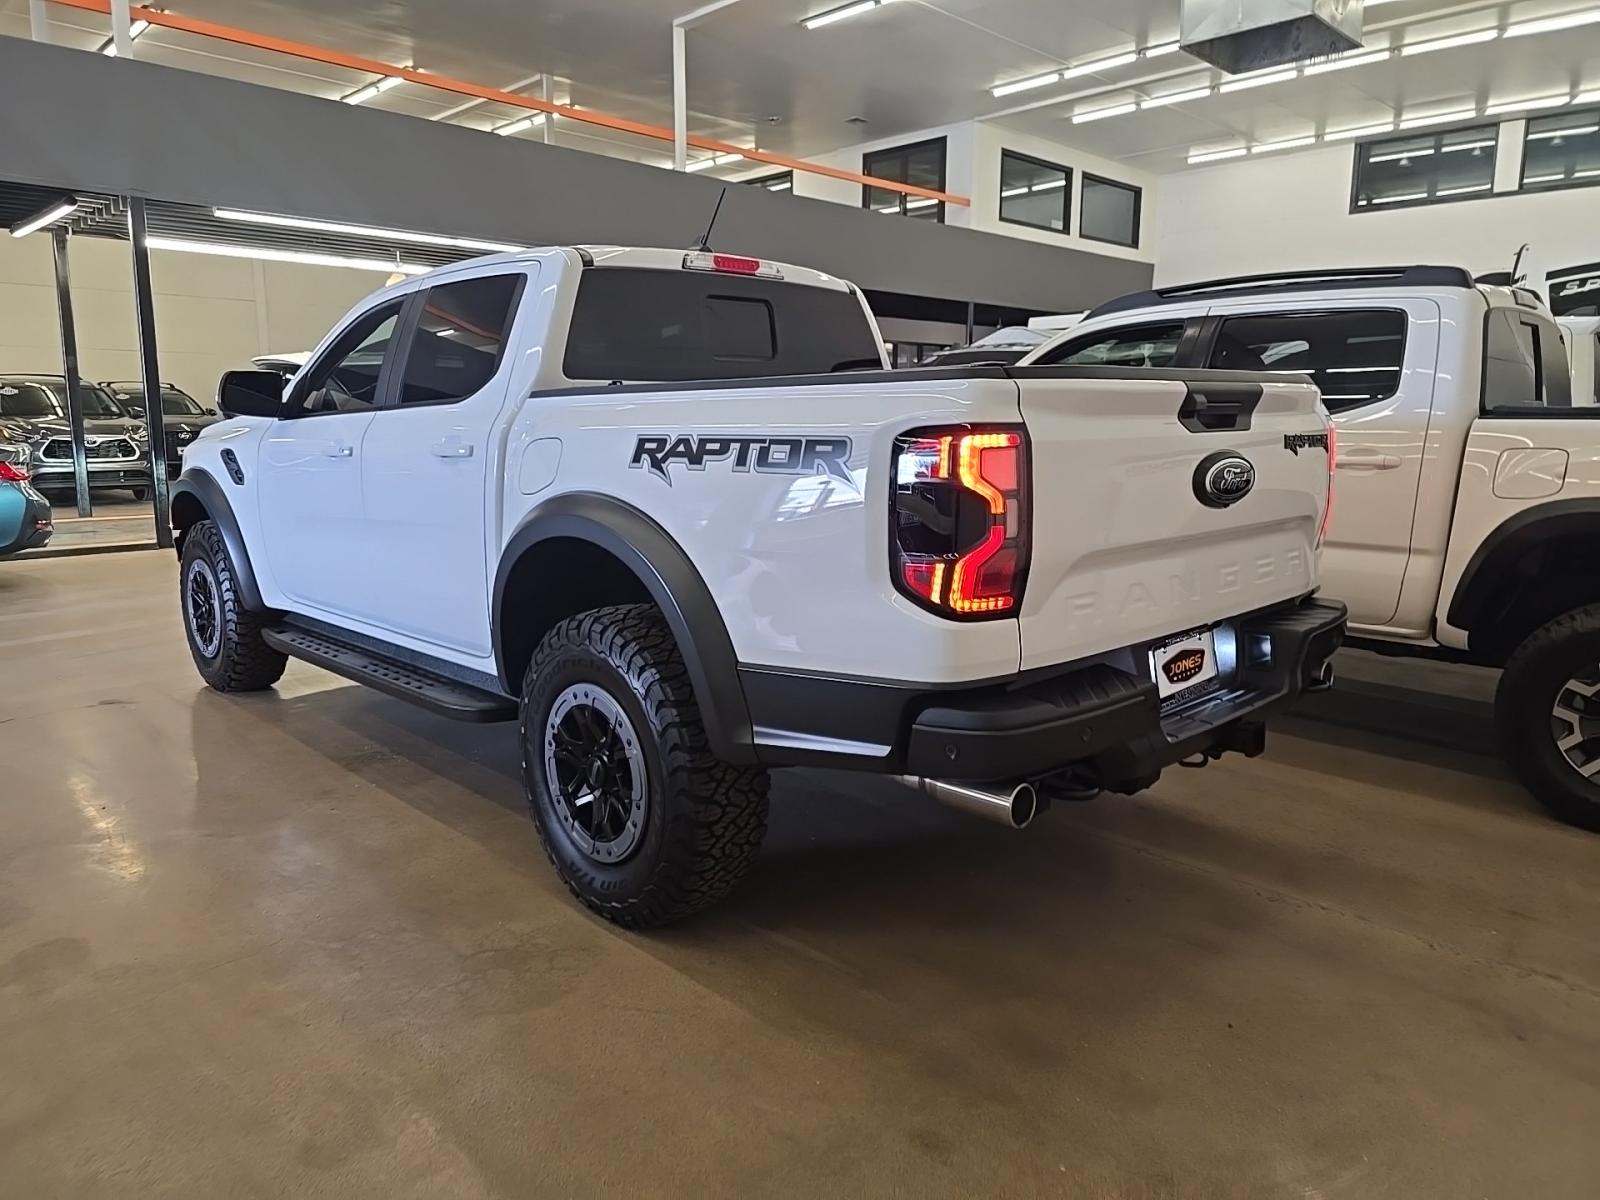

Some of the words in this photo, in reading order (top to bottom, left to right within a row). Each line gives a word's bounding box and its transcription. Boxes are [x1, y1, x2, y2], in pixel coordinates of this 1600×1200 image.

[1283, 433, 1329, 457] RAPTOR
[628, 434, 858, 486] RAPTOR
[1219, 466, 1249, 491] Ford
[1064, 549, 1303, 628] RANGER
[1169, 654, 1202, 677] JONES
